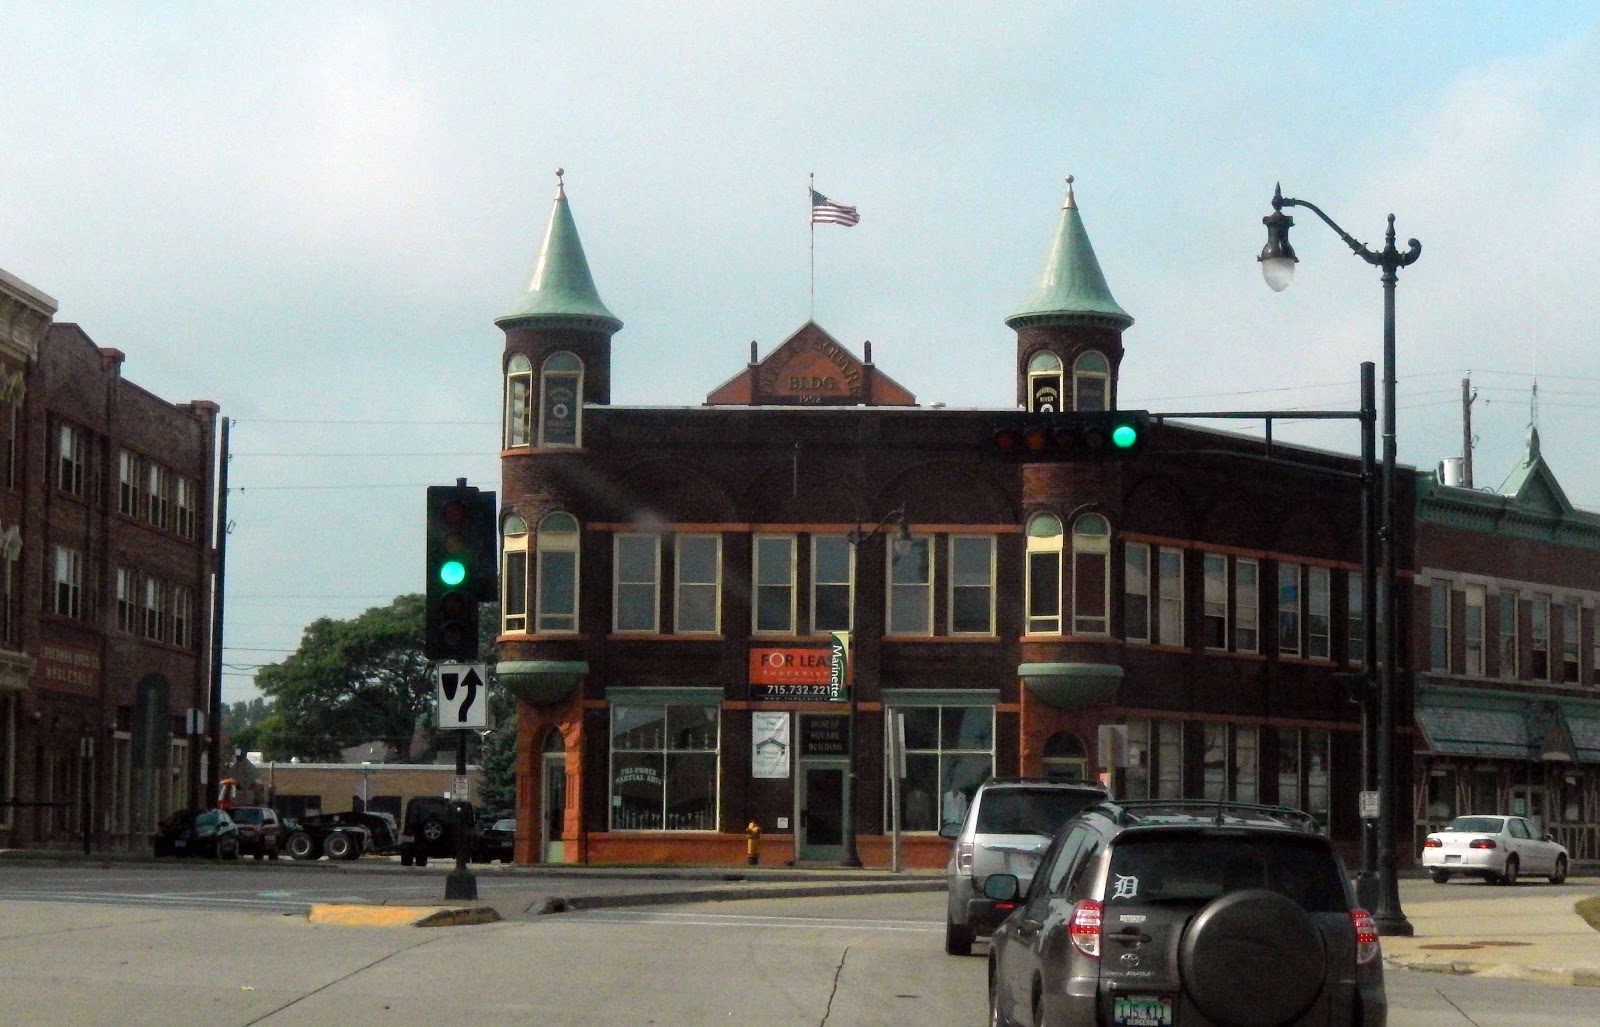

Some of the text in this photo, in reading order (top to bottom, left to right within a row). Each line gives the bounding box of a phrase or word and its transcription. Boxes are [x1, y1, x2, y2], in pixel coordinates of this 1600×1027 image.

[761, 652, 832, 668] FOR LEA
[831, 645, 843, 698] Marinette
[767, 685, 831, 695] 715.732.221
